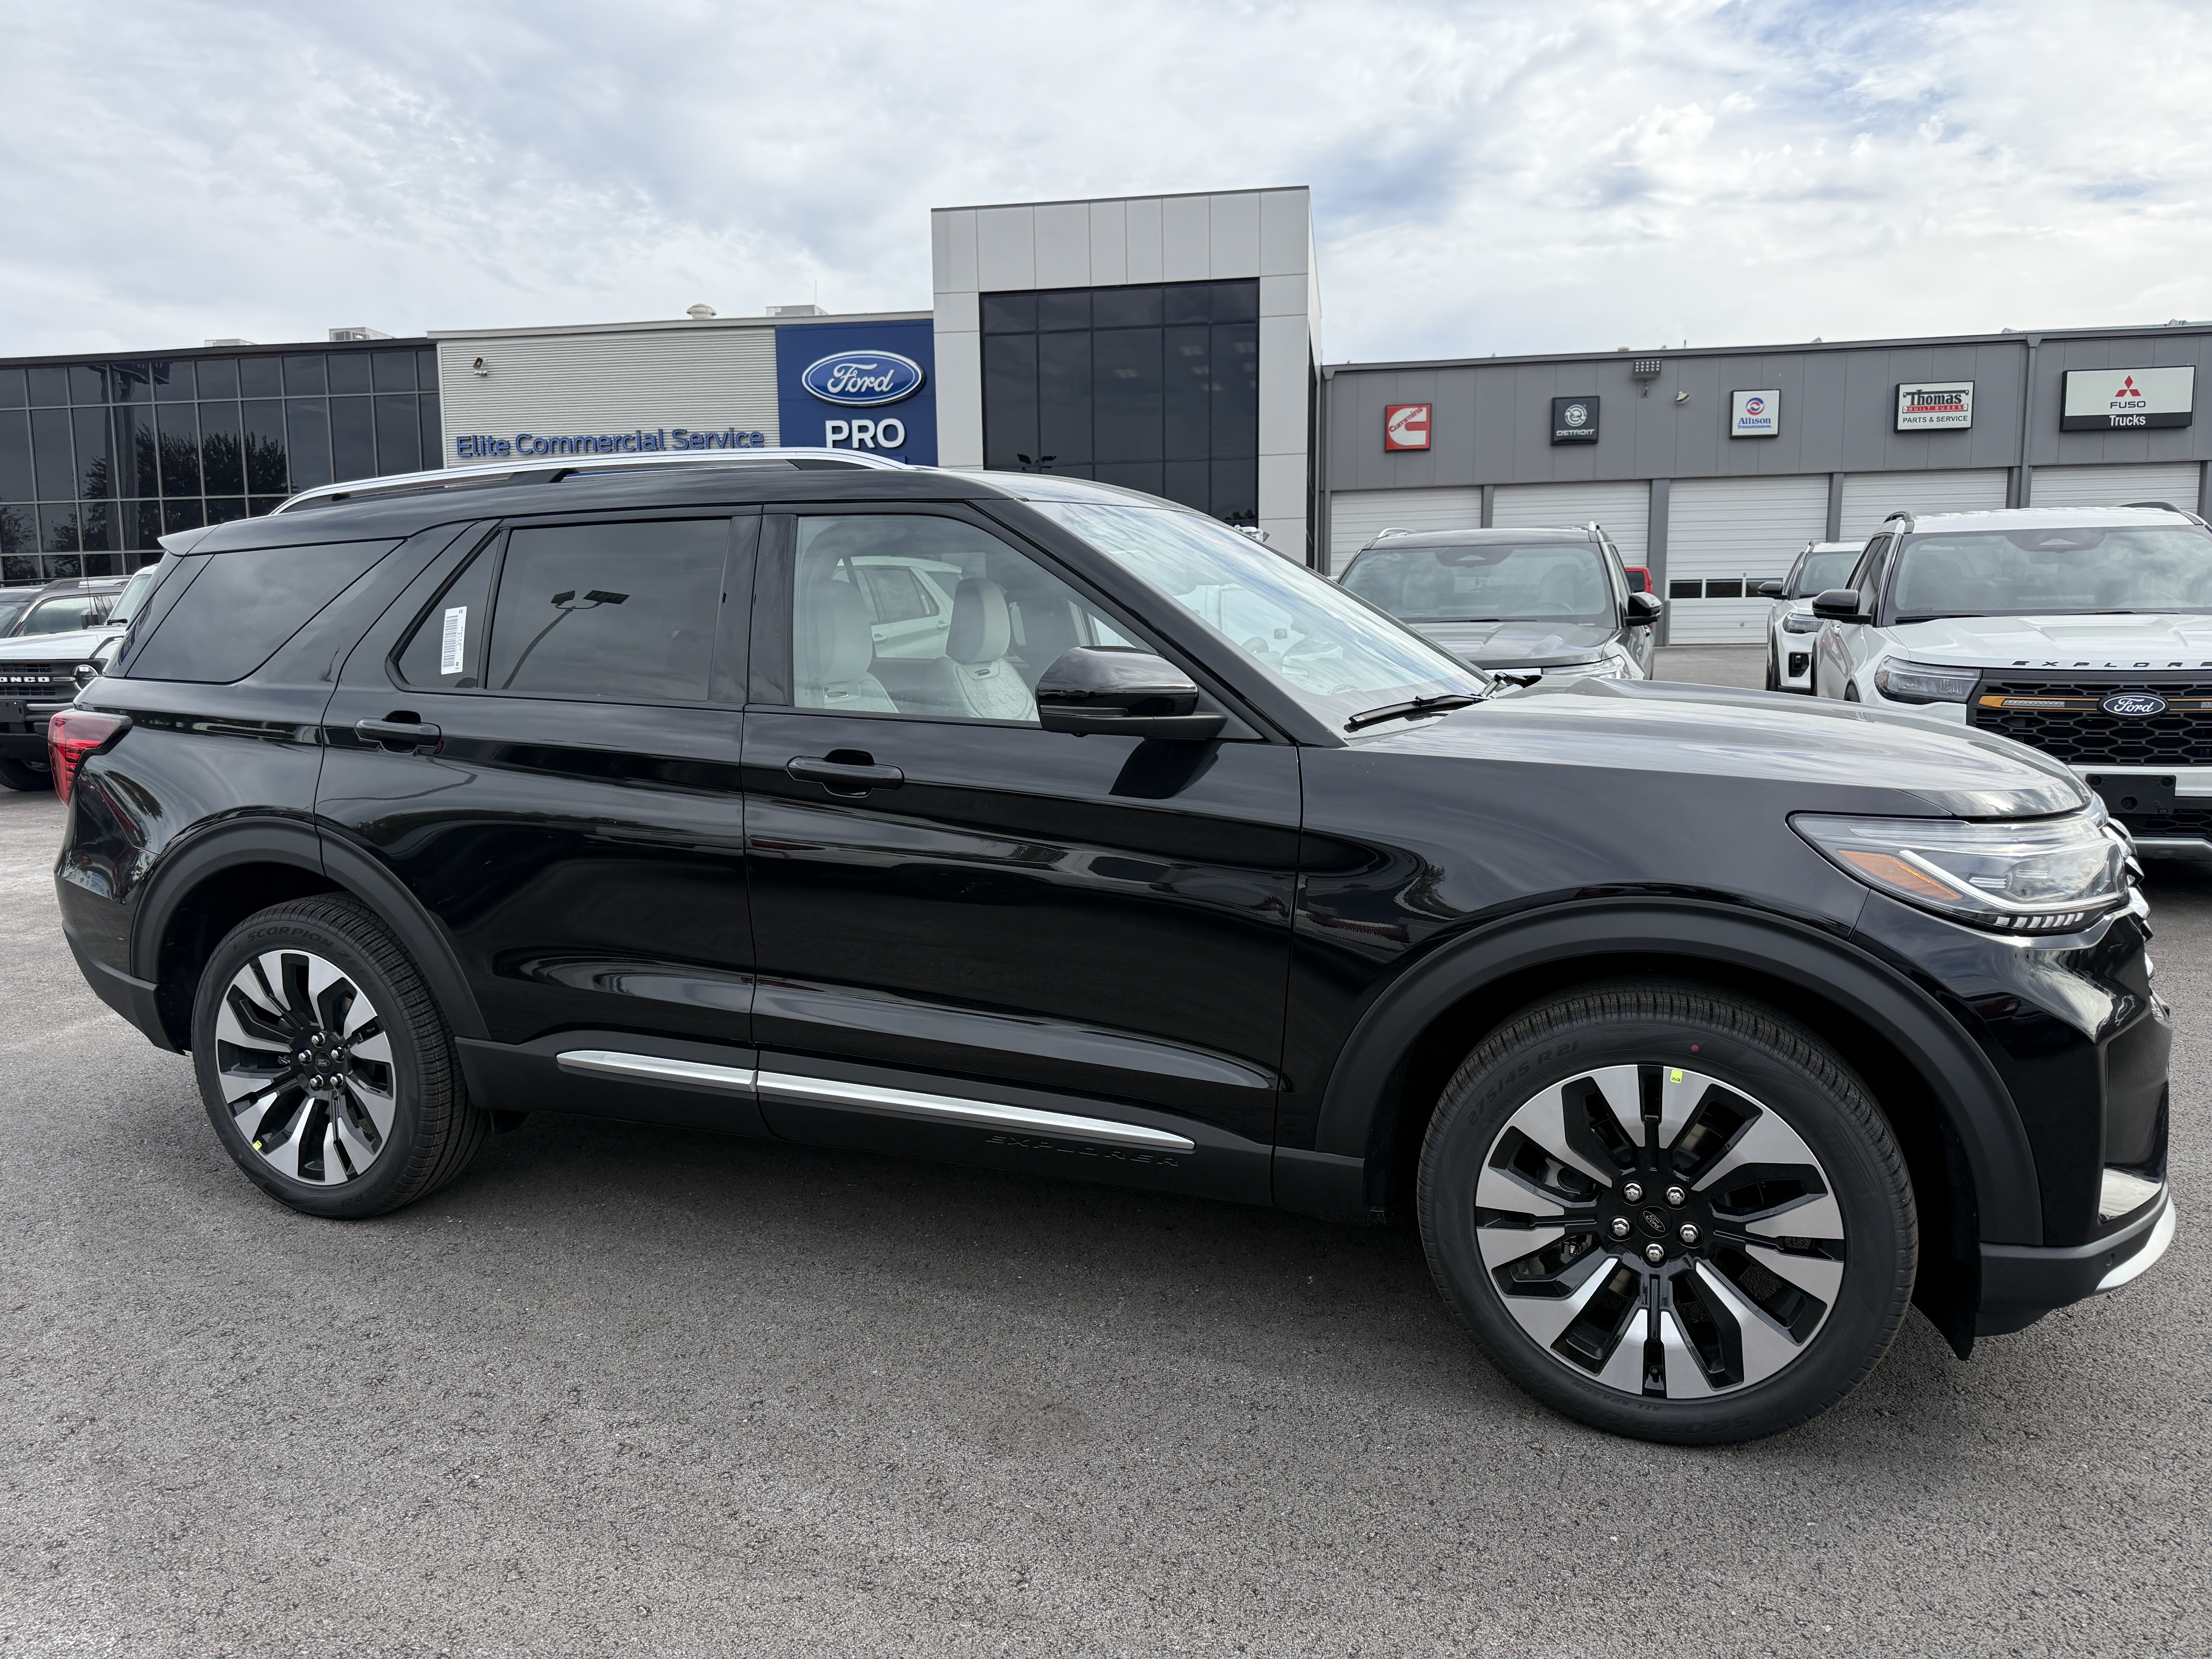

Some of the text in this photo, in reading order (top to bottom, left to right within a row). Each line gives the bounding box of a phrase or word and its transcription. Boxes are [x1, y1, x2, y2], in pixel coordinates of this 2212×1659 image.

[827, 363, 895, 393] Ford
[1909, 390, 1962, 406] Thomas
[1389, 408, 1423, 432] Cummins
[2109, 415, 2146, 426] Trucks
[456, 428, 764, 457] Elite Commercial Service
[826, 418, 905, 448] PRO
[2114, 698, 2154, 712] Ford
[247, 926, 334, 948] SCORPION
[1468, 1060, 1530, 1127] 275/45
[1537, 1040, 1579, 1065] R21
[985, 1135, 1178, 1166] EXPLORER
[1646, 1215, 1662, 1229] Ford
[1571, 1381, 1631, 1406] SEASON
